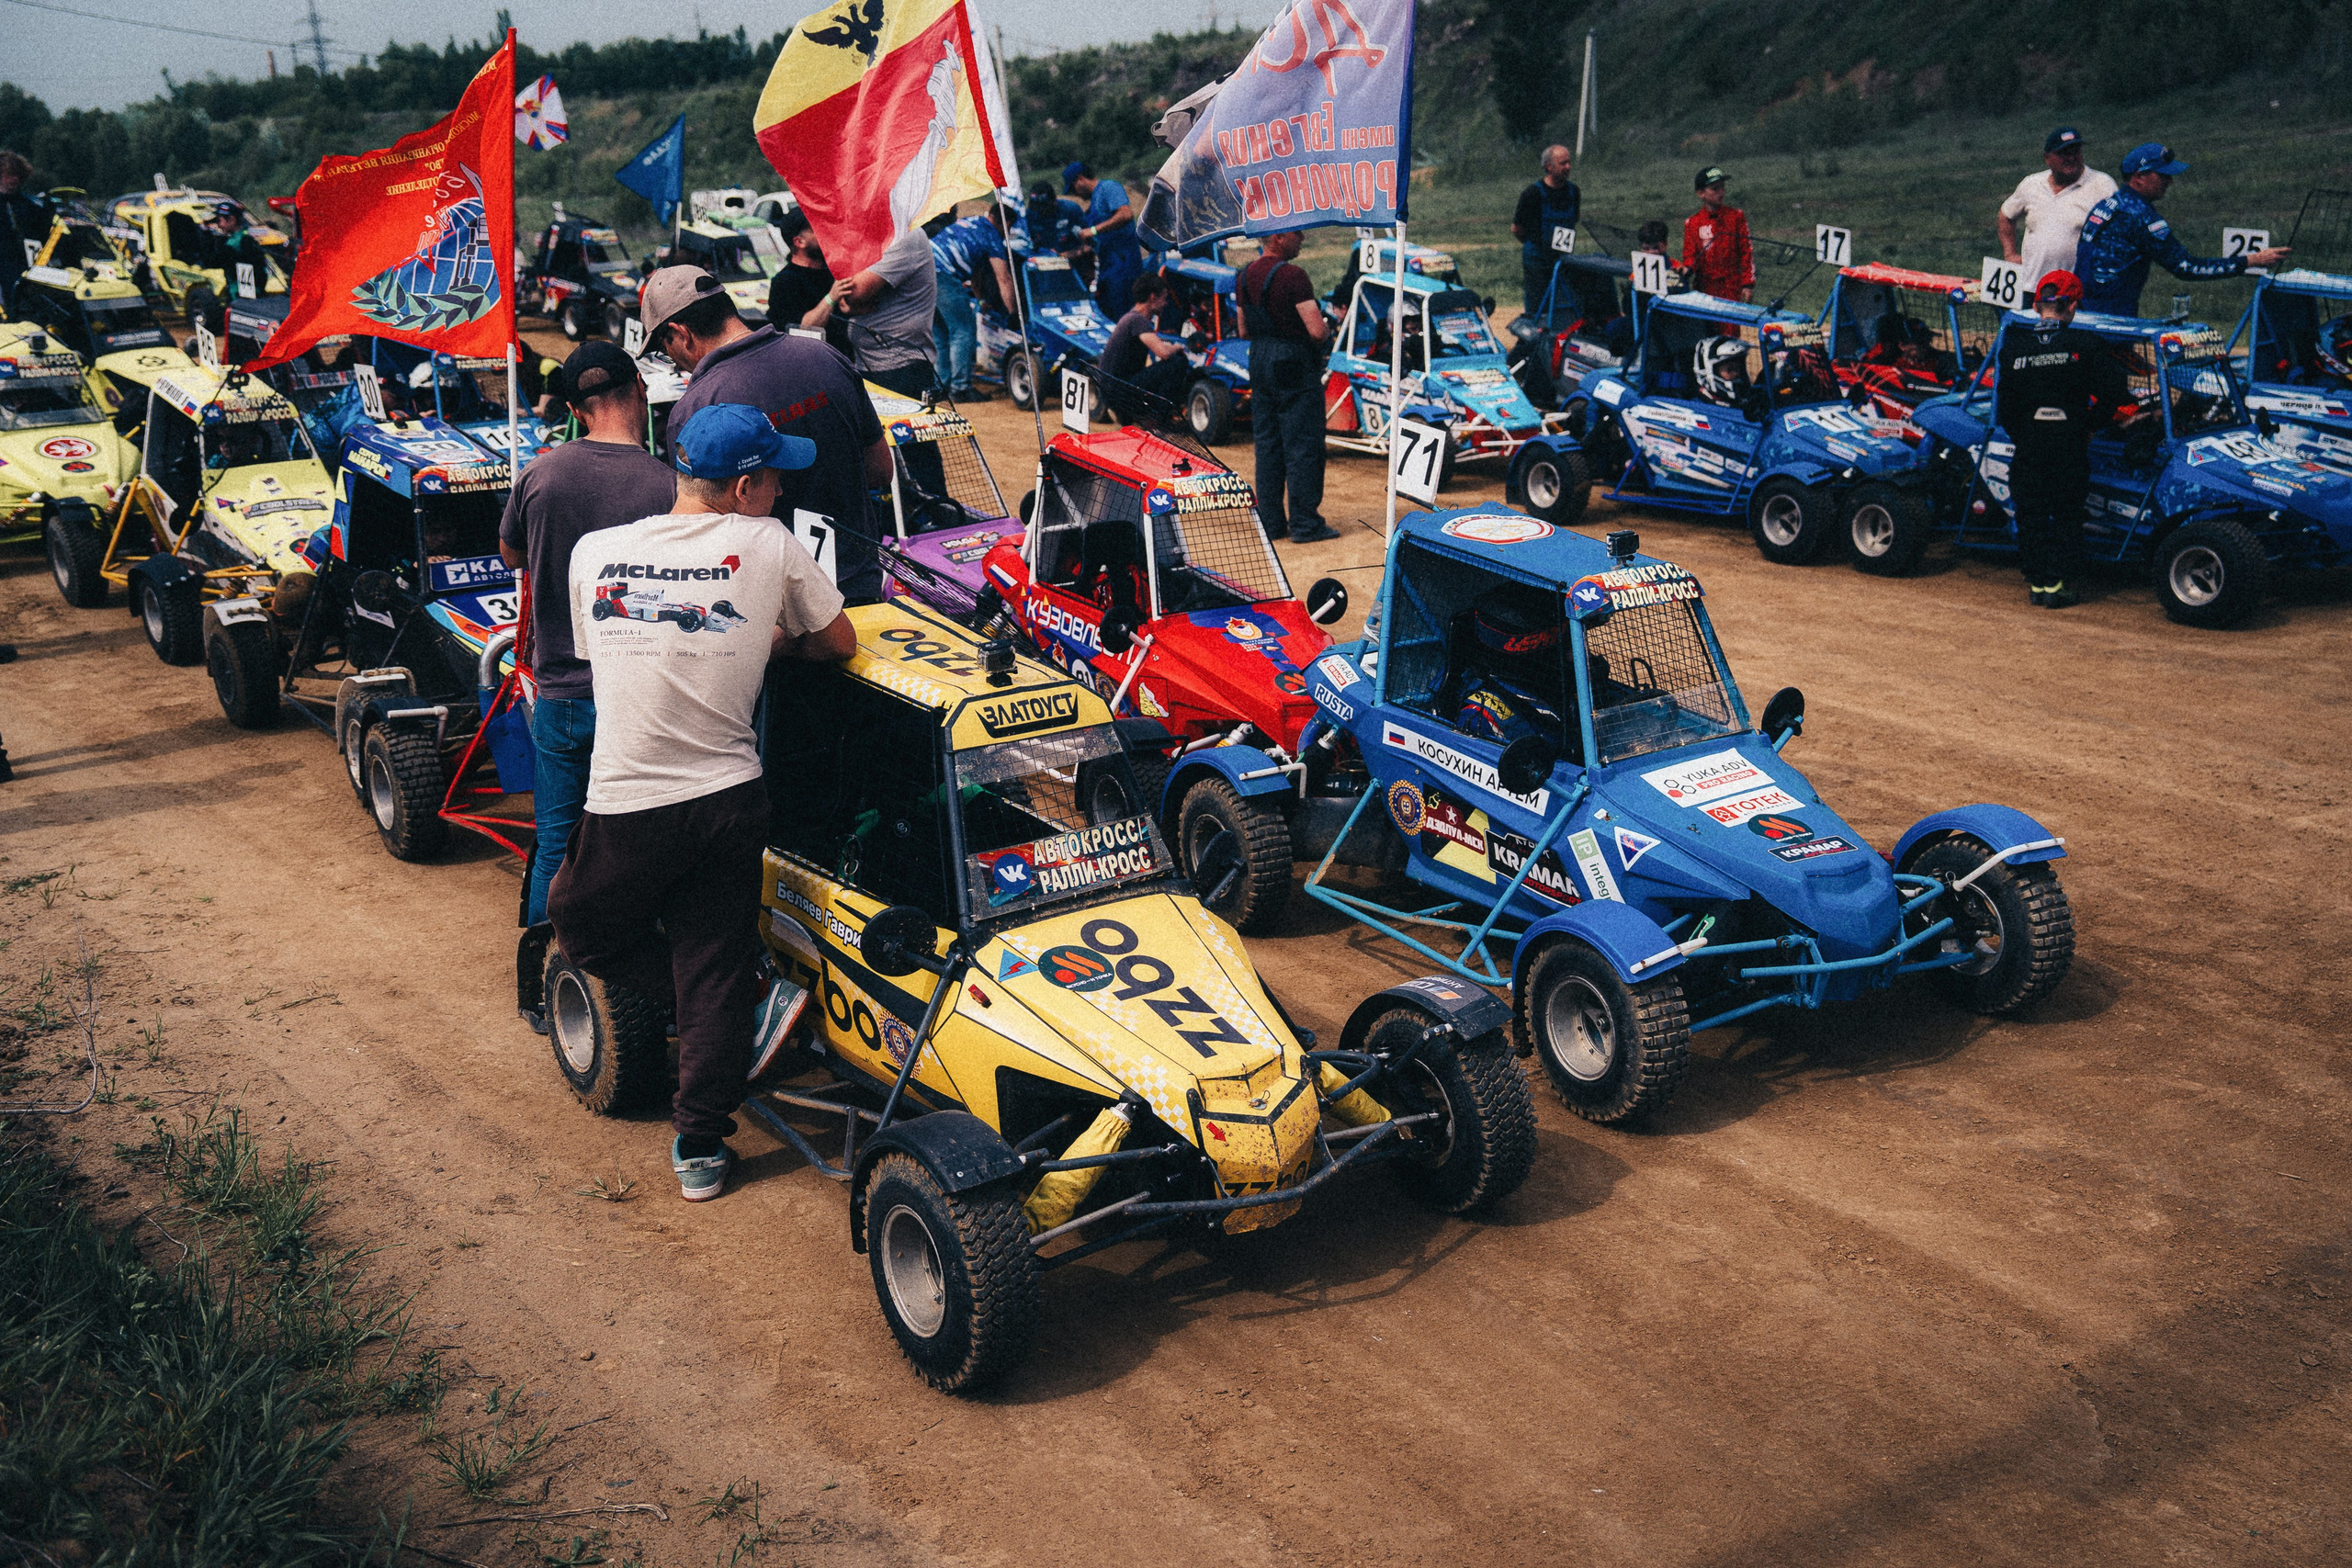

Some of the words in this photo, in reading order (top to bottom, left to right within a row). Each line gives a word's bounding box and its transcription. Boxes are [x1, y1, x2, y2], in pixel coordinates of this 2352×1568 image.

[1554, 230, 1572, 250] 24
[1820, 229, 1846, 262] 17
[2231, 234, 2264, 256] 25
[1366, 244, 1375, 269] 8
[1638, 257, 1664, 296] 11
[1986, 267, 2018, 304] 48
[359, 372, 380, 413] 30
[1065, 377, 1086, 414] 81
[769, 391, 828, 428] CLAAS
[1368, 407, 1379, 431] 8
[1397, 427, 1440, 487] 71
[447, 464, 511, 483] АВТОКРОС
[1150, 494, 1170, 506] VK
[1177, 491, 1253, 514] РАЛЛИ-КРОСС
[809, 525, 827, 562] 7
[469, 558, 504, 574] КА
[597, 563, 729, 581] McLaren
[1576, 588, 1599, 602] VK
[1609, 580, 1700, 610] РАЛЛИ-КРОСС
[600, 629, 641, 637] FORMULA-1
[1026, 595, 1115, 658] КУЗОВЛЕ
[982, 691, 1076, 729] ЗЛАТОУСТ
[1316, 683, 1352, 721] RUSTA
[1418, 739, 1483, 783] КОСУХИН
[1682, 767, 1720, 784] YUKA
[1721, 759, 1747, 774] ADV
[1701, 779, 1720, 789] PRO
[1720, 770, 1753, 784] RACING
[1728, 792, 1791, 813] TOTEK
[1033, 817, 1145, 868] АВТОКРОСС/
[1576, 837, 1594, 855] IP
[1780, 840, 1843, 858] КРАМАР
[998, 863, 1027, 883] VK
[1038, 846, 1152, 896] РАЛЛИ-КРОСС
[776, 881, 823, 922] Беляев
[823, 909, 862, 950] Гаври
